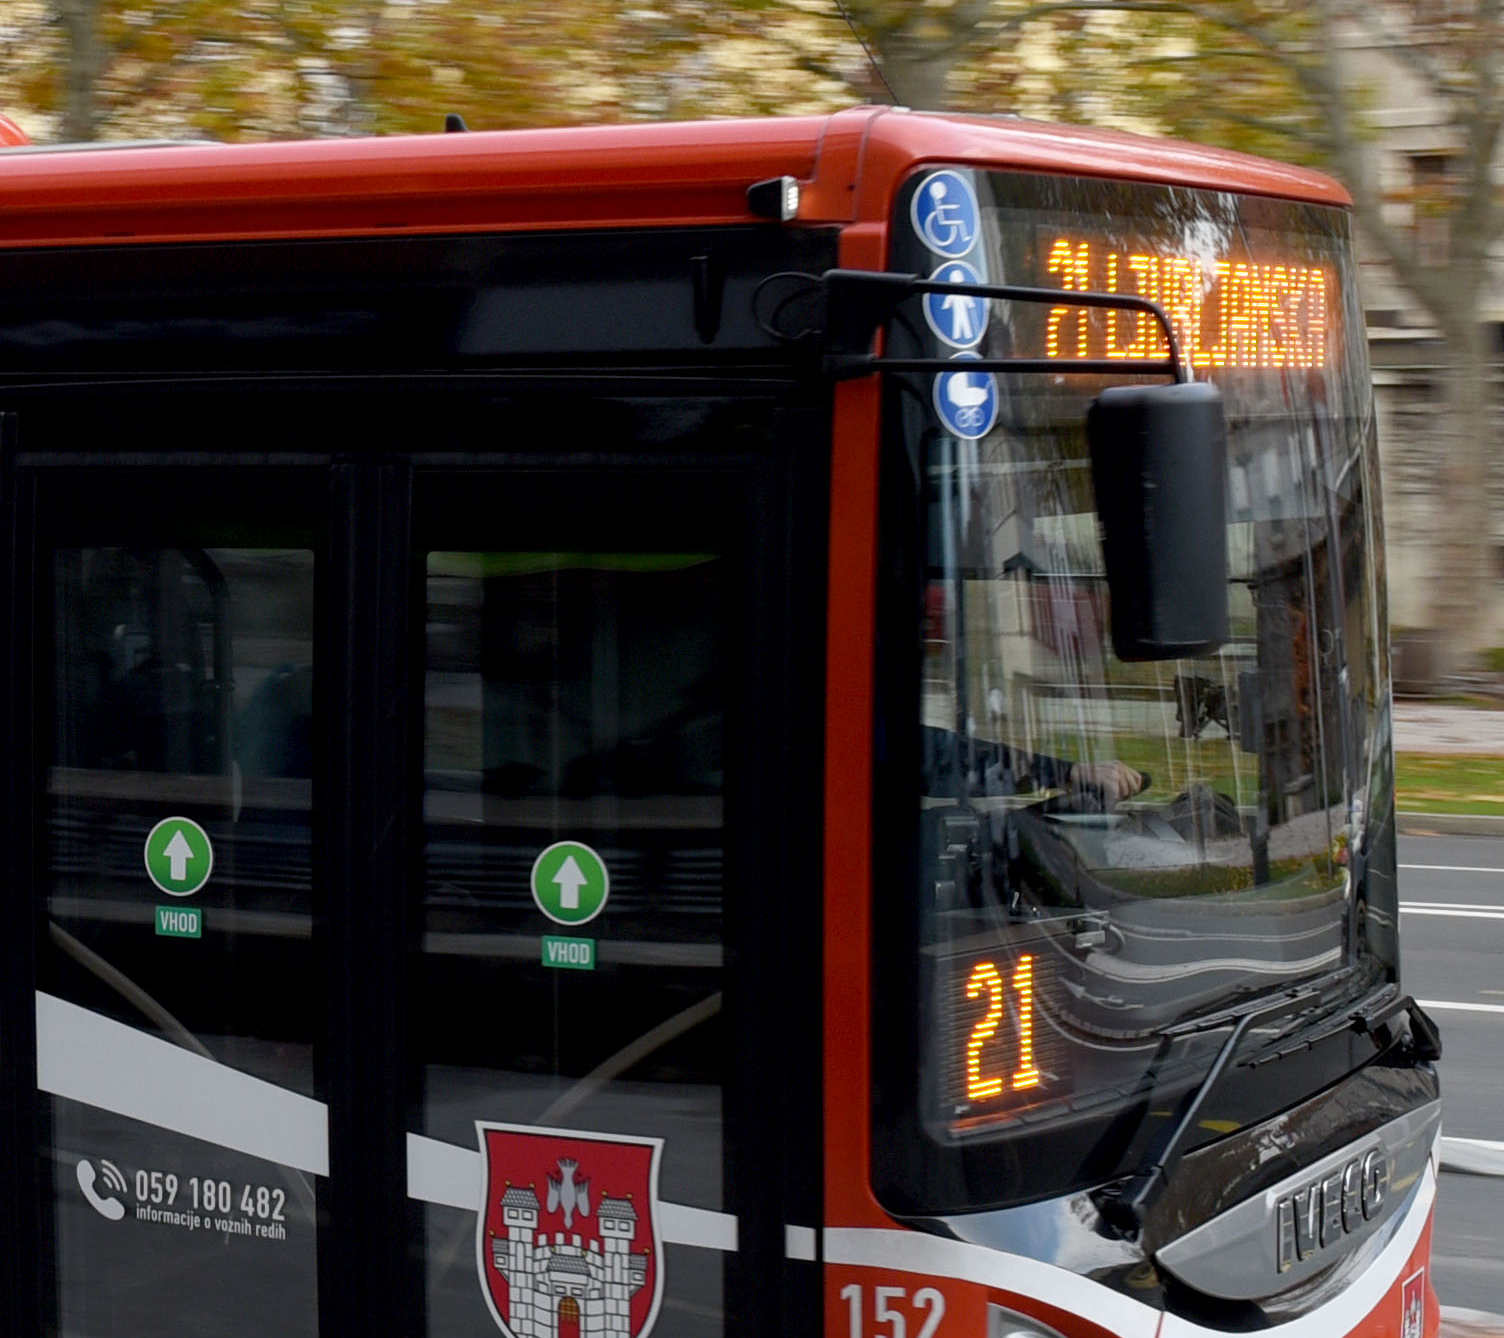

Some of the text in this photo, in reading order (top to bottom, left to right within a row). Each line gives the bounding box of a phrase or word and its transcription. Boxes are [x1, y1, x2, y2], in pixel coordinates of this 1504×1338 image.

[1047, 238, 1089, 356] 21
[160, 911, 198, 933] VHOD
[547, 941, 591, 965] VHOD
[966, 955, 1040, 1100] 21
[135, 1169, 286, 1221] 059 180 482
[1276, 1146, 1388, 1274] IVECO
[136, 1203, 286, 1240] informacije o voznih redih
